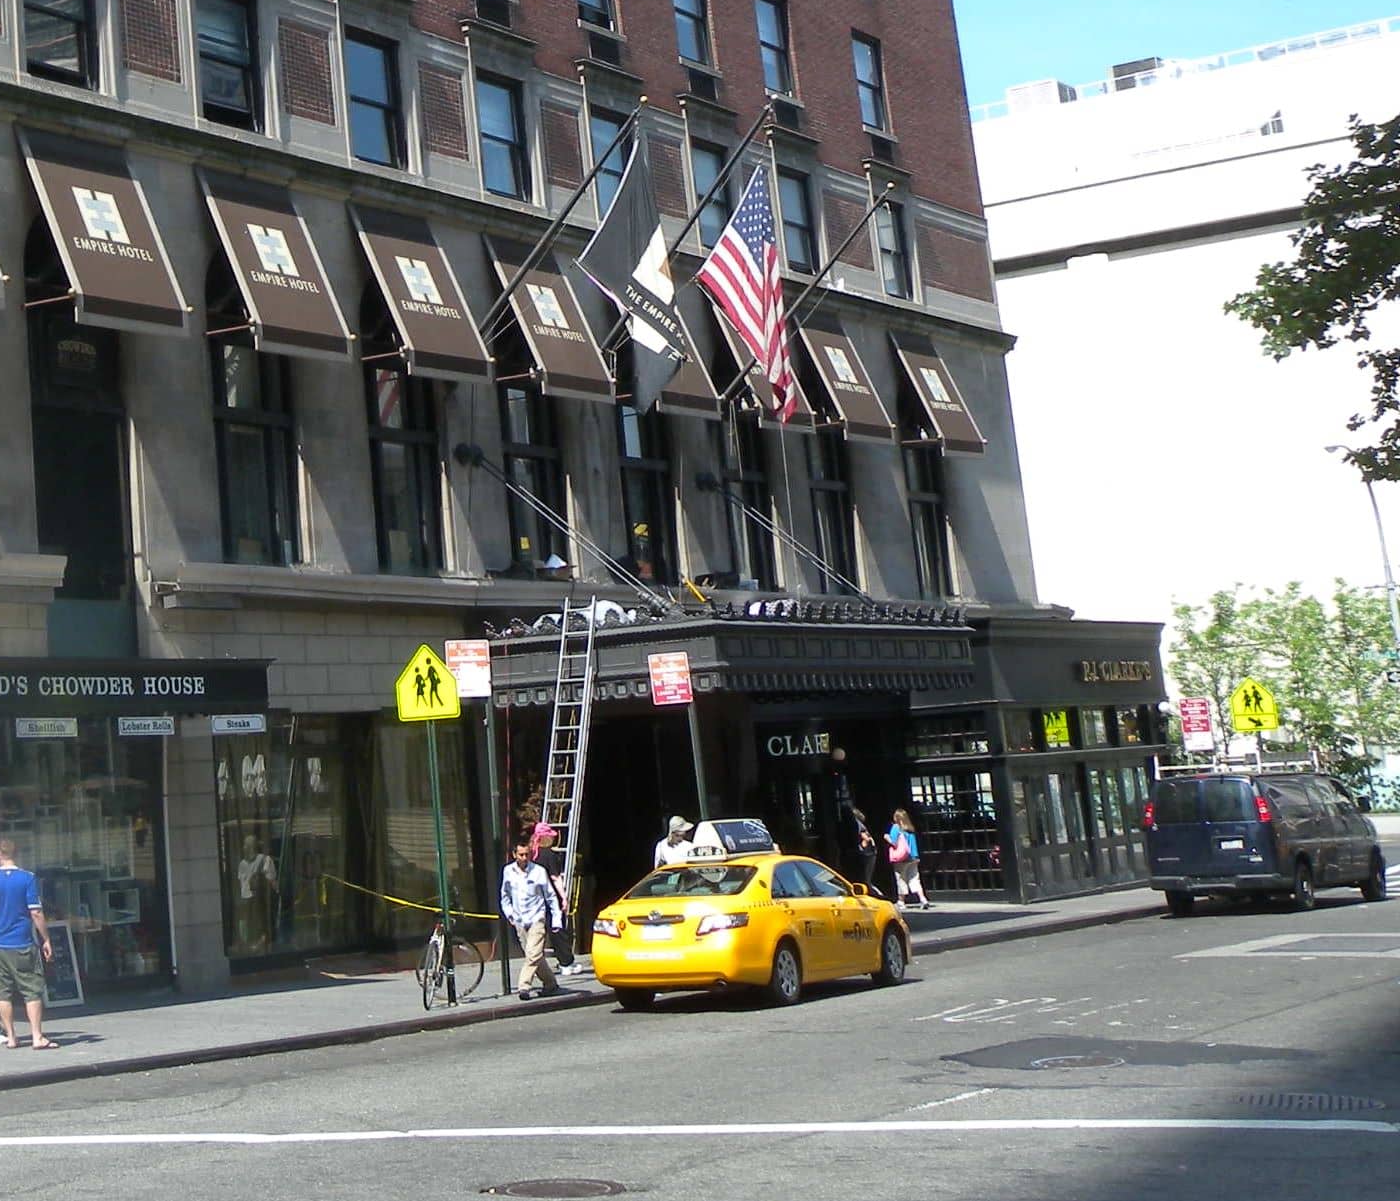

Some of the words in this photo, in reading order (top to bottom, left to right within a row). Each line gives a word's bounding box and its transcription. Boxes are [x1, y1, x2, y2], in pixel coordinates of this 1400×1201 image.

[73, 237, 116, 255] EMPIRE
[117, 244, 154, 262] HOTEL
[250, 270, 288, 288] EMPIRE
[288, 277, 320, 294] HOTEL
[625, 284, 643, 305] THE
[641, 300, 678, 333] EMPIRE
[38, 676, 136, 696] CHOWDER
[143, 676, 205, 695] HOUSE
[121, 720, 150, 731] Lobster
[152, 720, 173, 731] Rolls
